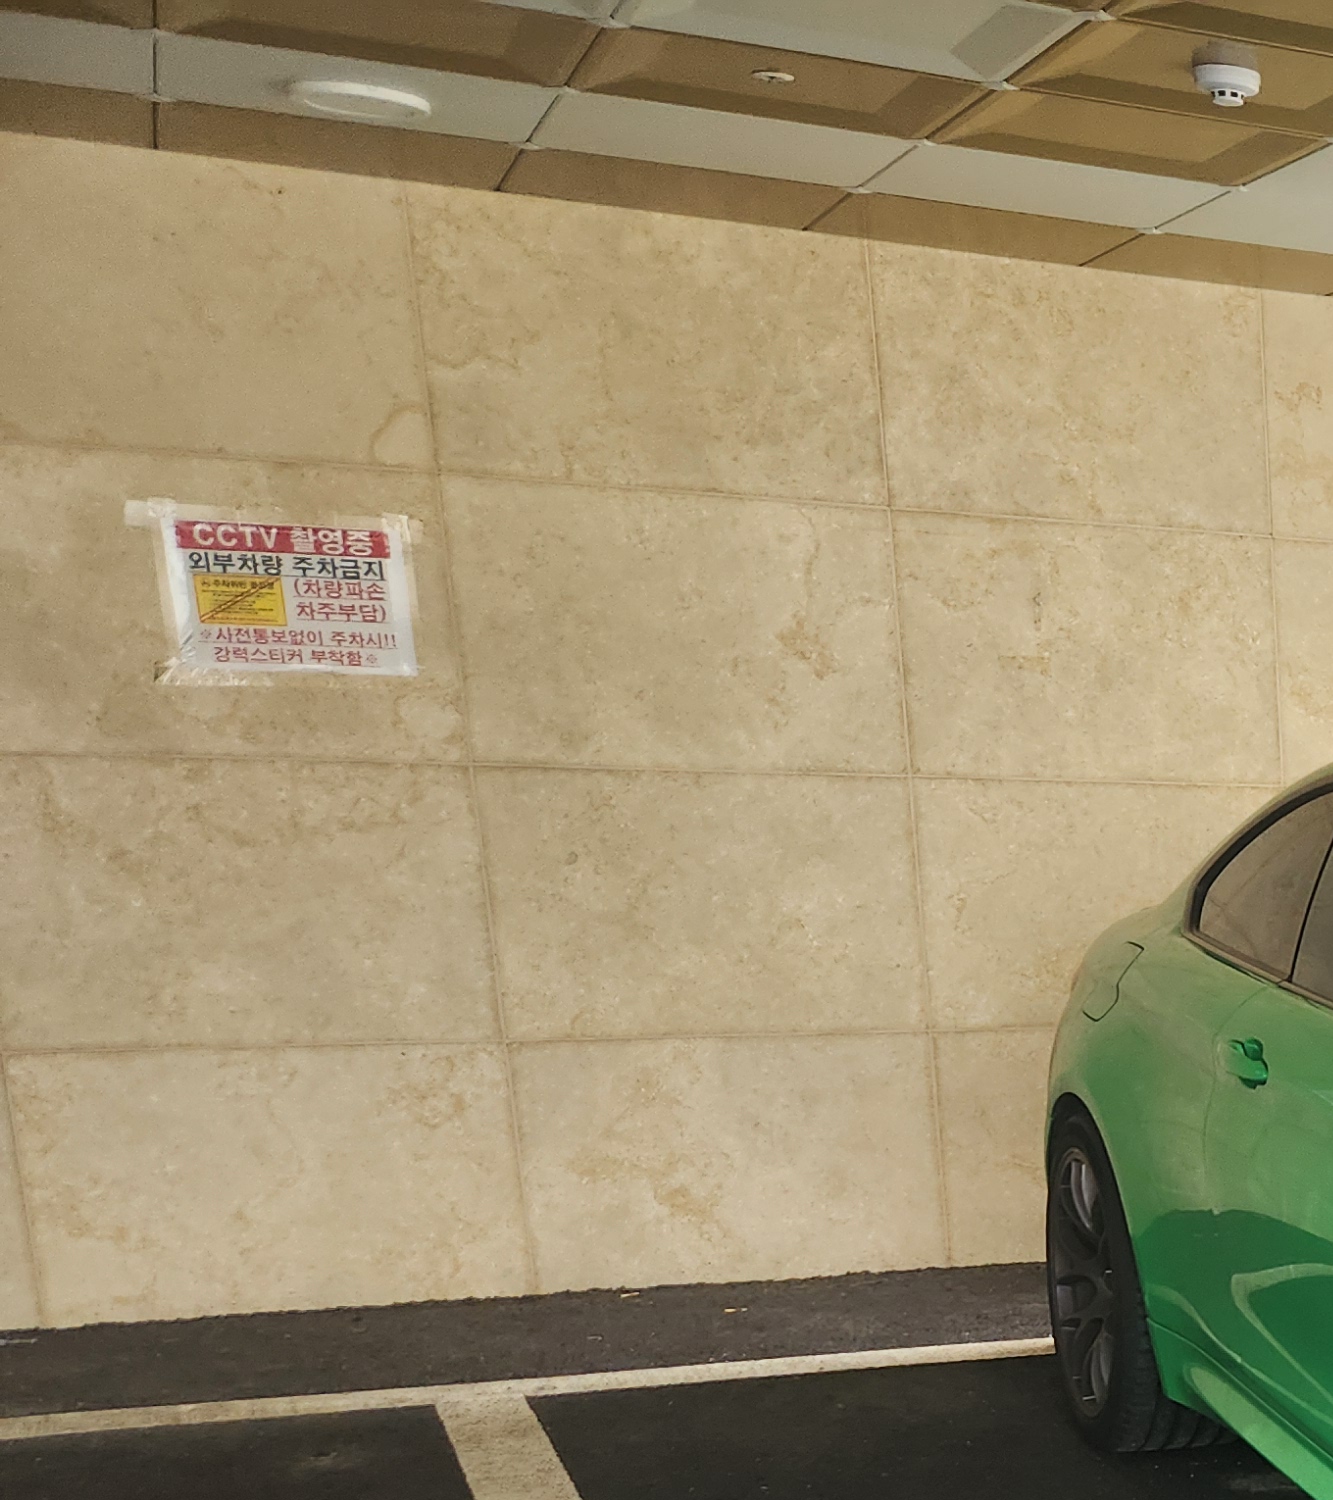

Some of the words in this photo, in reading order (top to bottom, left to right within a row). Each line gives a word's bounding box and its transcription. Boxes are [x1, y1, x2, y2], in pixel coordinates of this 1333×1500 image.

[193, 523, 279, 549] CCTV
[290, 526, 372, 556] 촬영중
[188, 552, 284, 577] 외부차량
[292, 556, 386, 581] 주차금지
[294, 578, 386, 601] (차량파손
[296, 601, 387, 623] 차주부담)
[216, 627, 324, 646] 사전통보없이
[330, 630, 398, 649] 주차시!!
[214, 646, 304, 664] 강력스티커
[310, 649, 363, 666] 부착함
